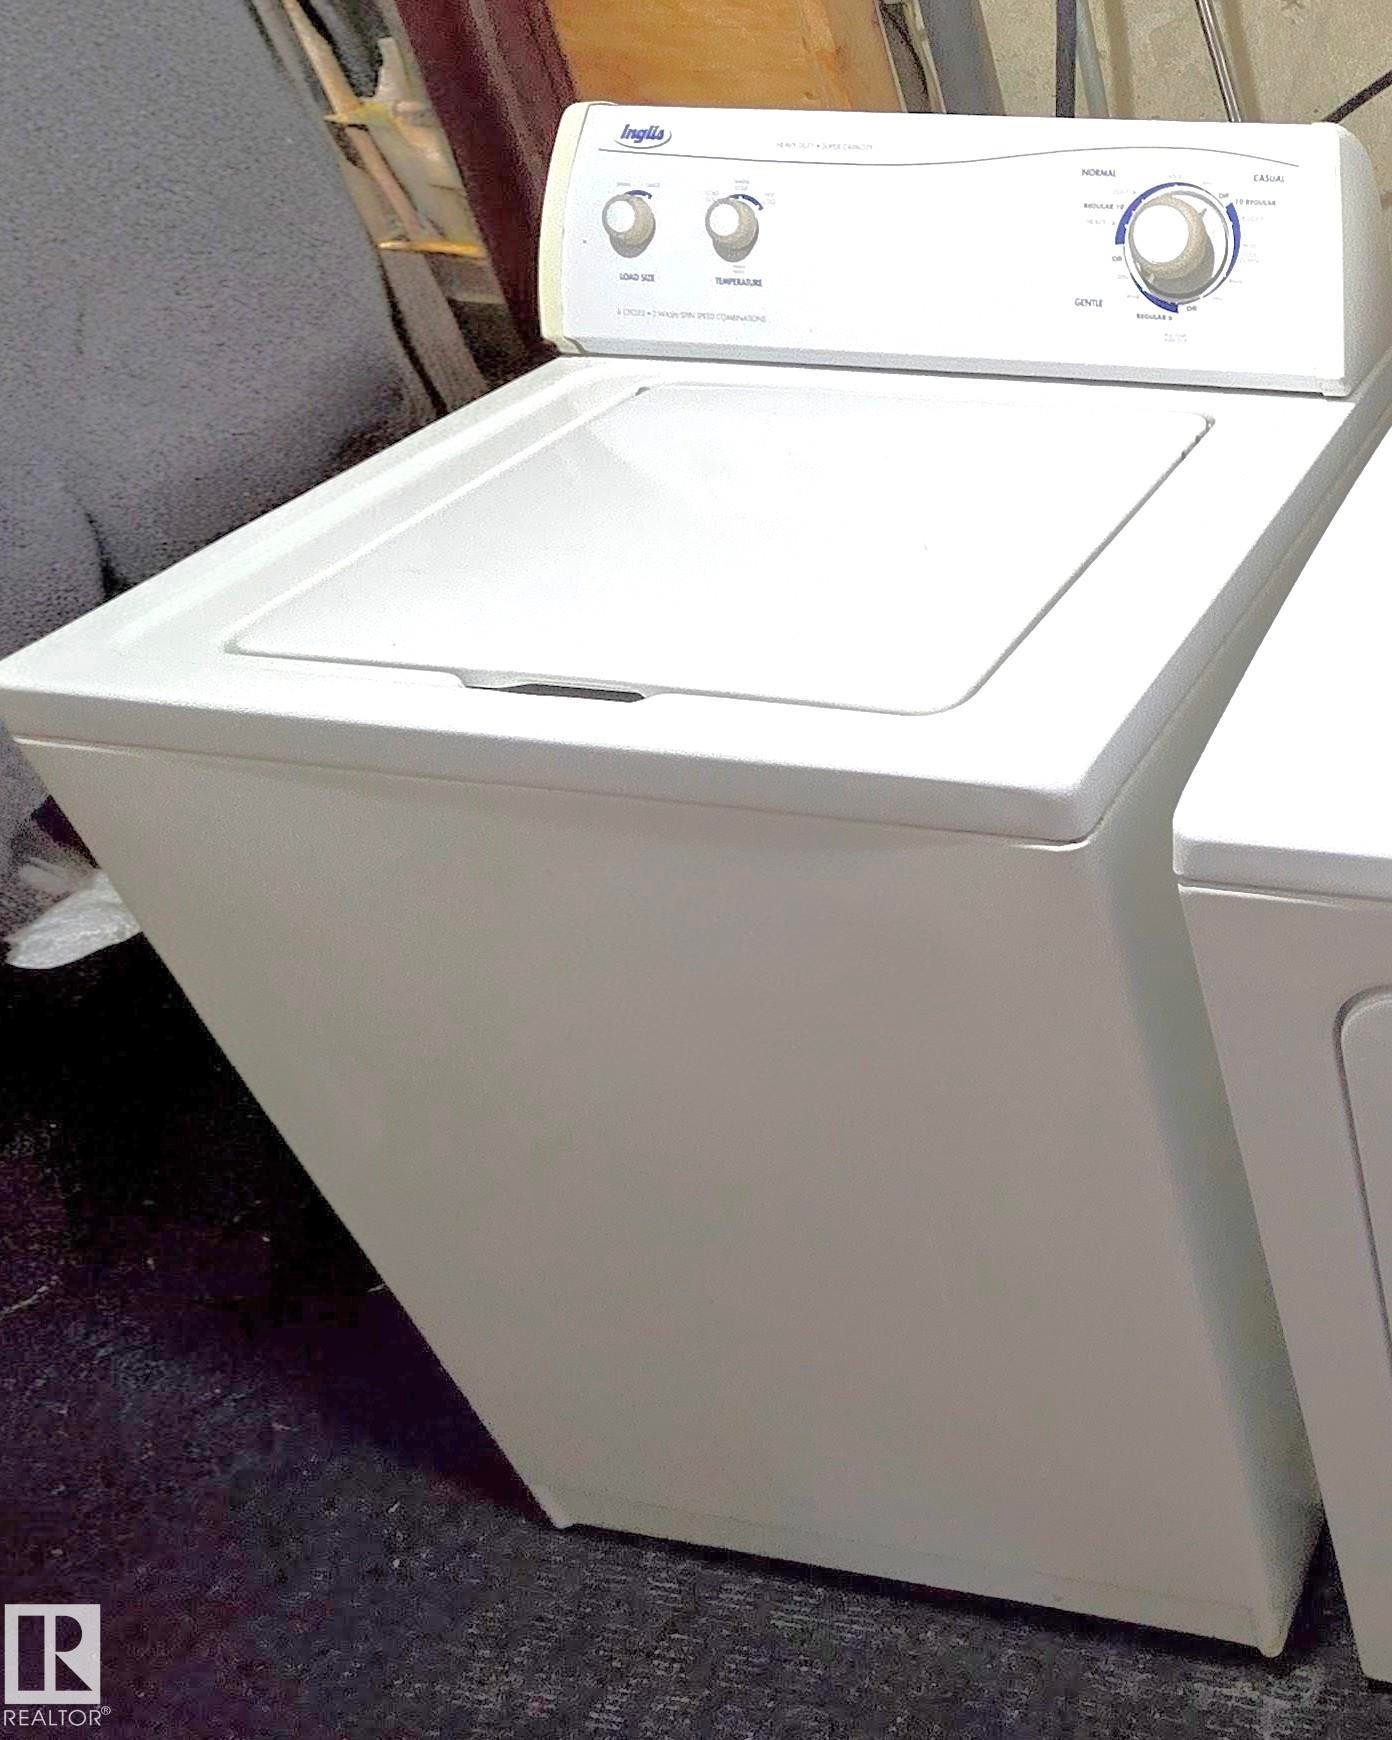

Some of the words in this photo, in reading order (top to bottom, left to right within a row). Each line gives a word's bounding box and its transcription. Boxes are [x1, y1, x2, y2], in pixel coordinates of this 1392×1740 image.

[619, 123, 665, 144] Inglis
[1081, 168, 1116, 177] NORMAL
[1253, 174, 1285, 183] CASUAL
[619, 272, 640, 282] LOAD
[641, 274, 655, 283] SIZE
[715, 276, 763, 288] TEMPERATURE
[1074, 297, 1103, 308] GENTLE
[1136, 313, 1166, 321] REGULAR
